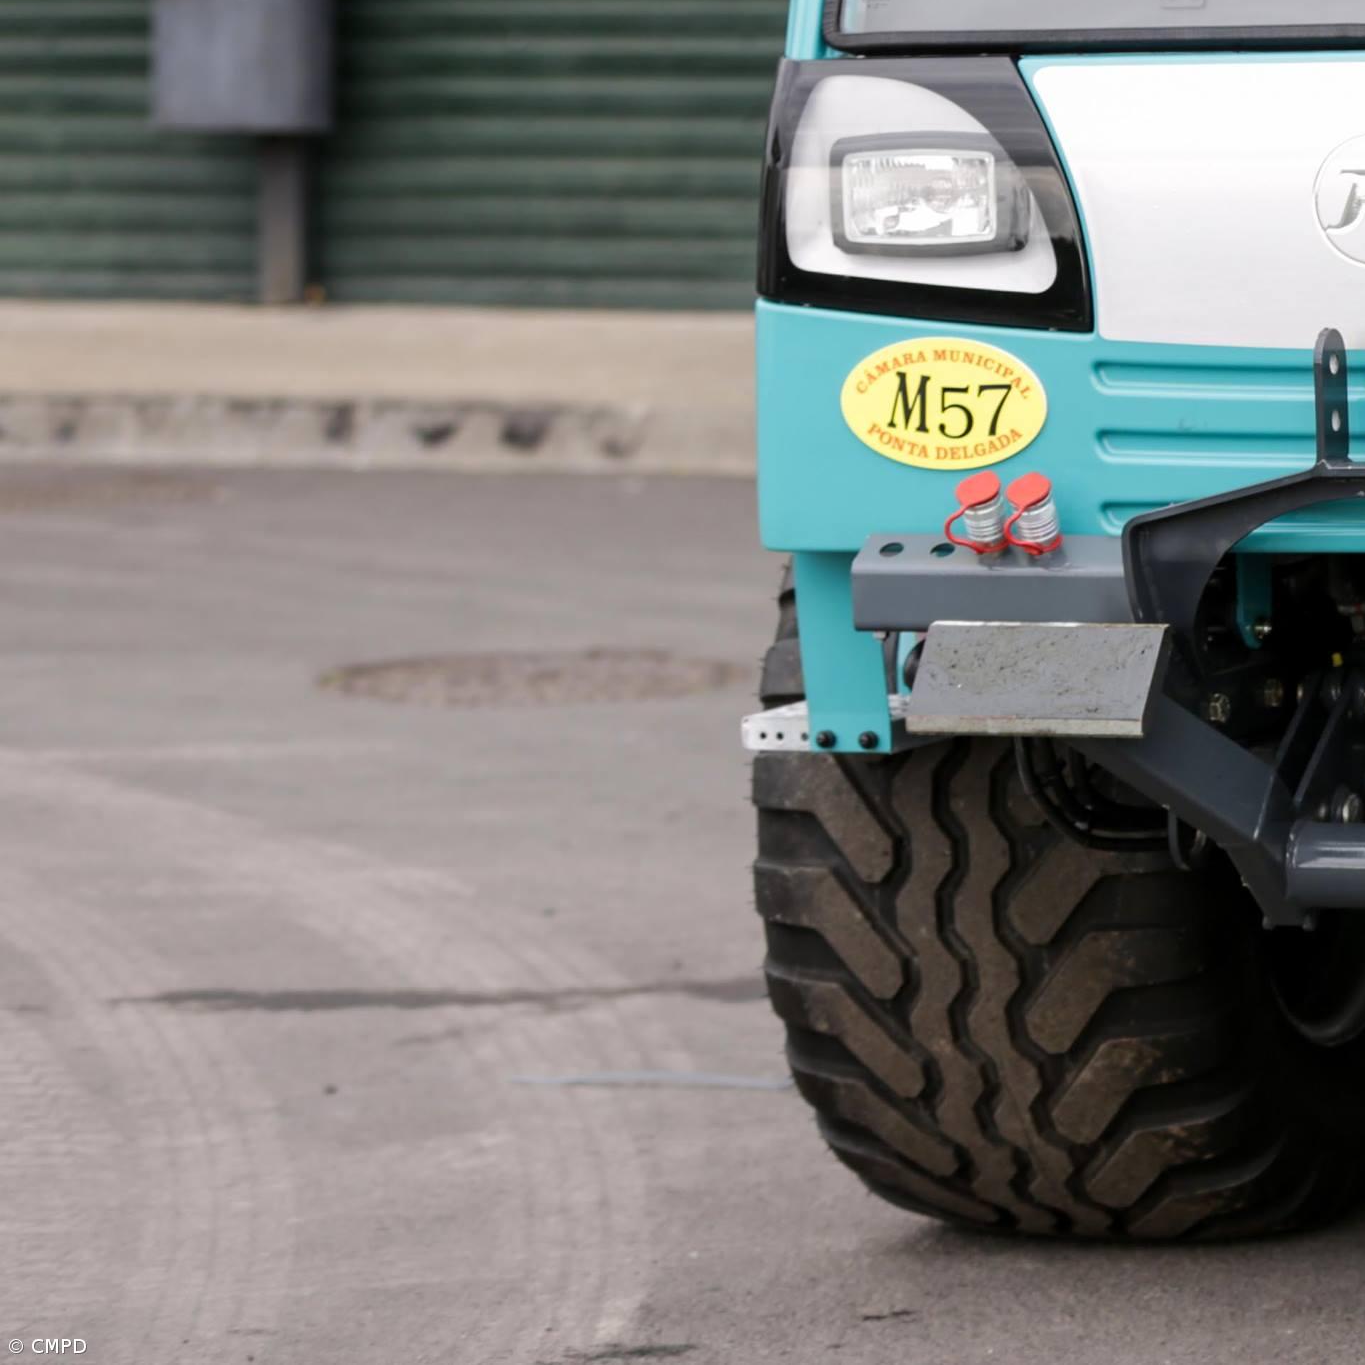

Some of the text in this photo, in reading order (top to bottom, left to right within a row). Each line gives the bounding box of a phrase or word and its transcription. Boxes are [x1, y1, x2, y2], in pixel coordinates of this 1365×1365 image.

[856, 348, 1034, 400] CÂMARA MUNICIPAL
[887, 370, 1012, 439] M57
[867, 422, 1024, 460] PONTA DELGADA
